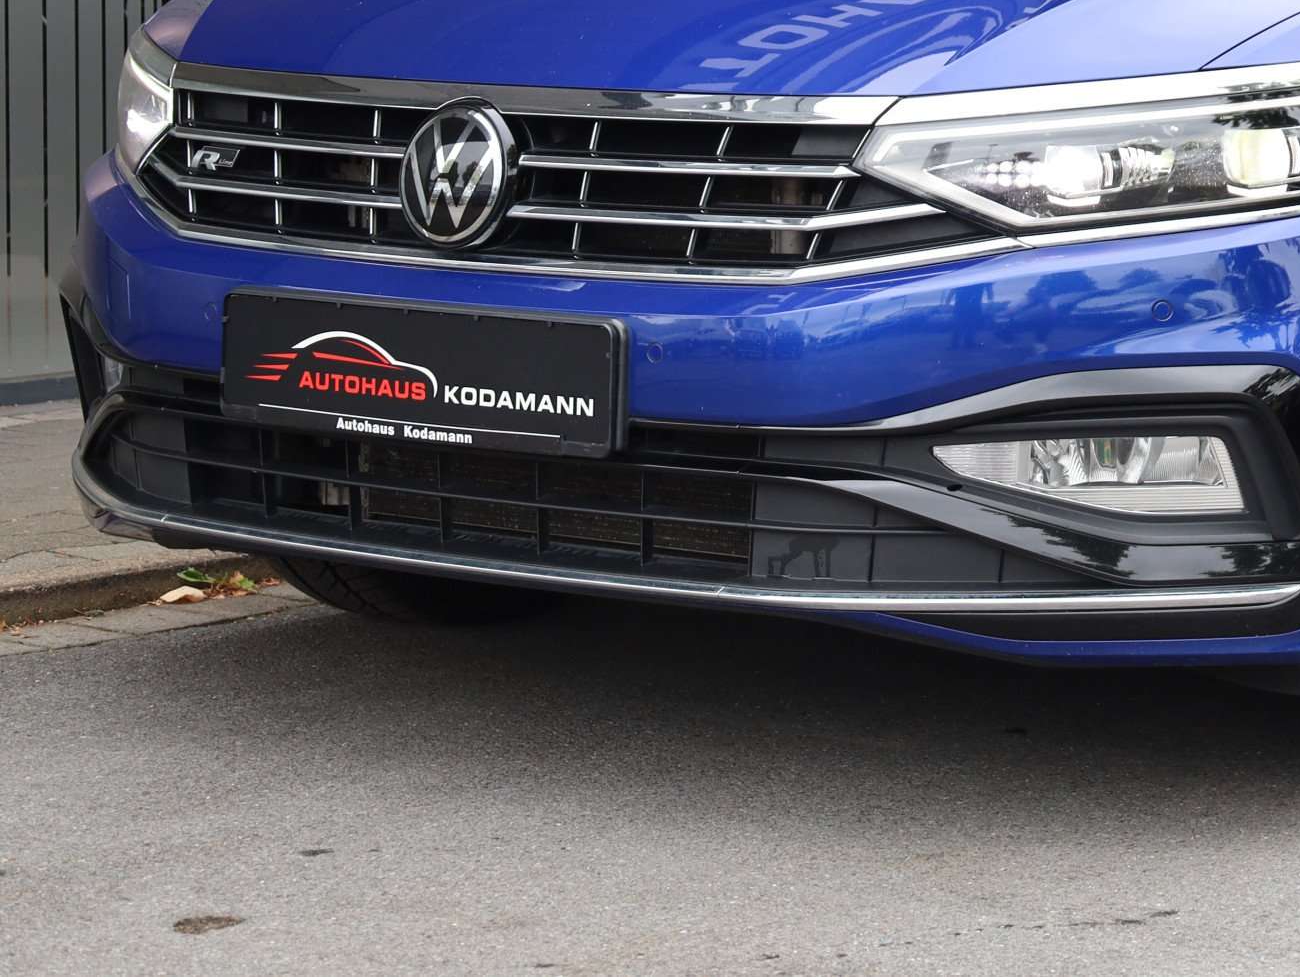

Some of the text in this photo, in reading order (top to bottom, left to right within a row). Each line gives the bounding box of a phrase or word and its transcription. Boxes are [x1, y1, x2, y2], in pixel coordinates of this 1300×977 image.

[299, 370, 594, 417] AUTOHAUS KODAMANN
[335, 416, 473, 445] Autohaus Kodamann
